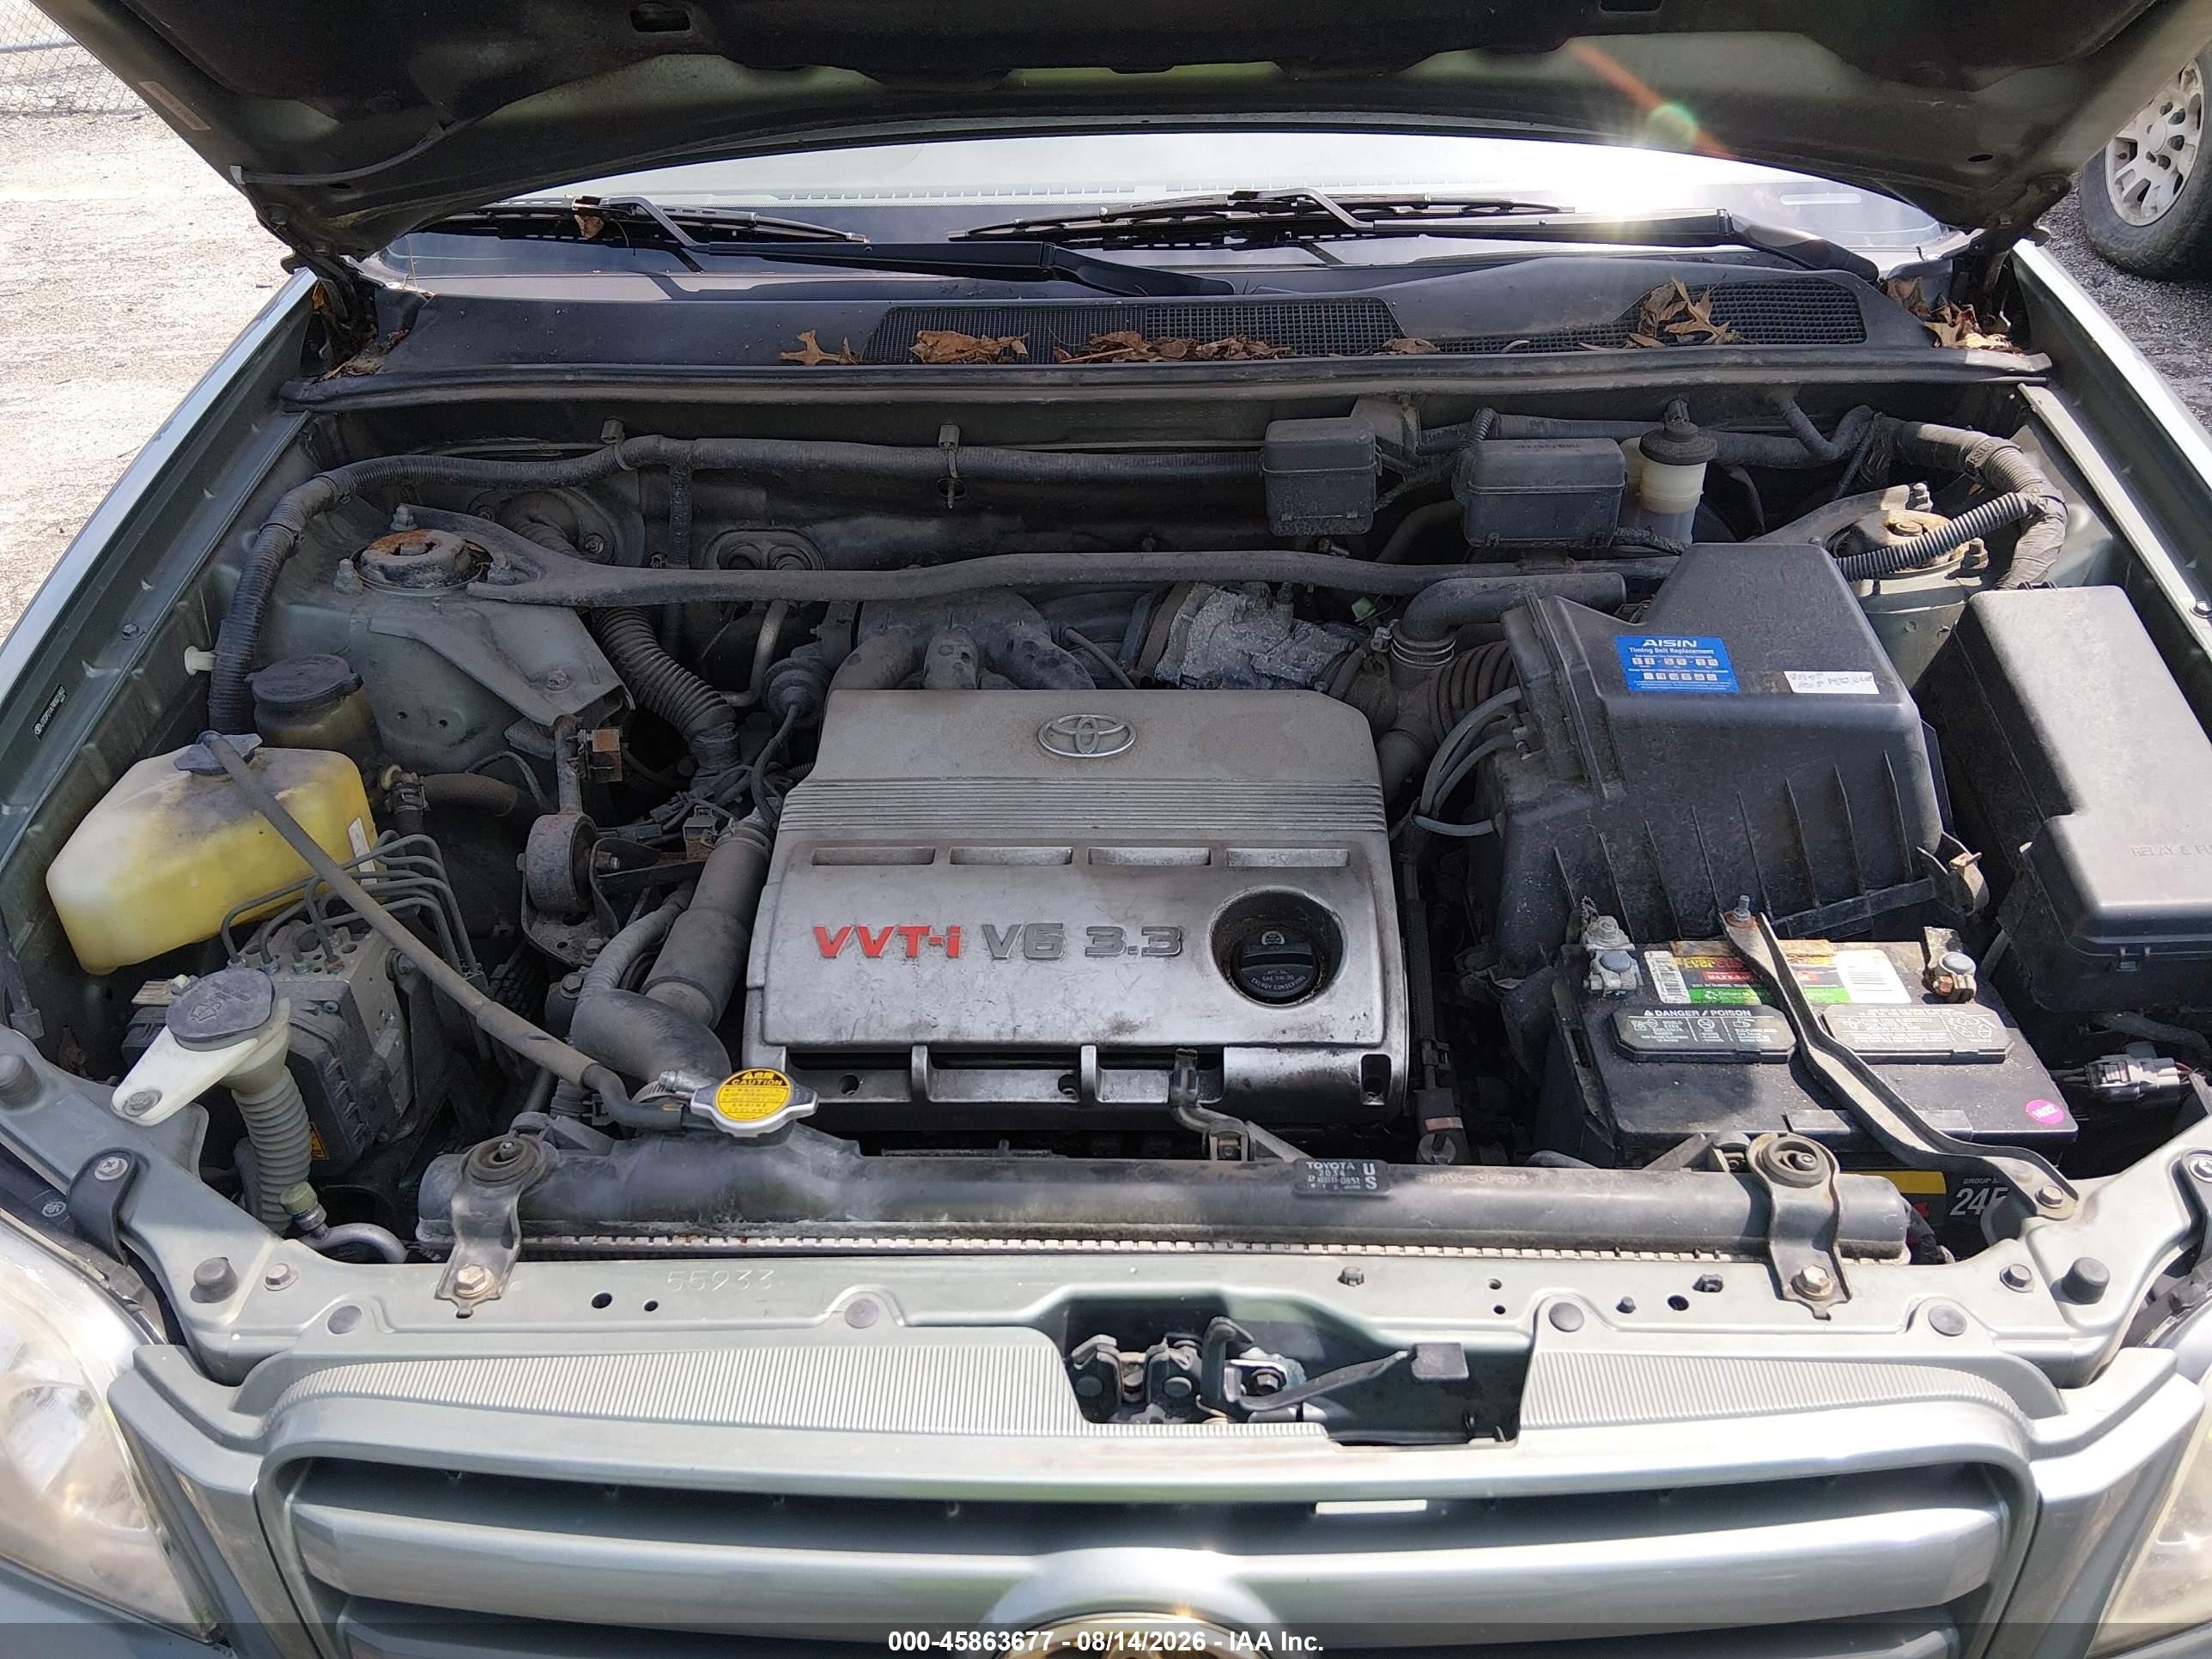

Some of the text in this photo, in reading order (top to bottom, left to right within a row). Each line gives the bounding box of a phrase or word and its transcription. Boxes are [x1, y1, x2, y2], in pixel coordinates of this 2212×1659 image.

[1643, 639, 1698, 647] AISIN
[2130, 845, 2173, 857] RELAY
[812, 922, 1184, 960] VVT-i V6 3.3
[667, 1269, 775, 1291] 55933
